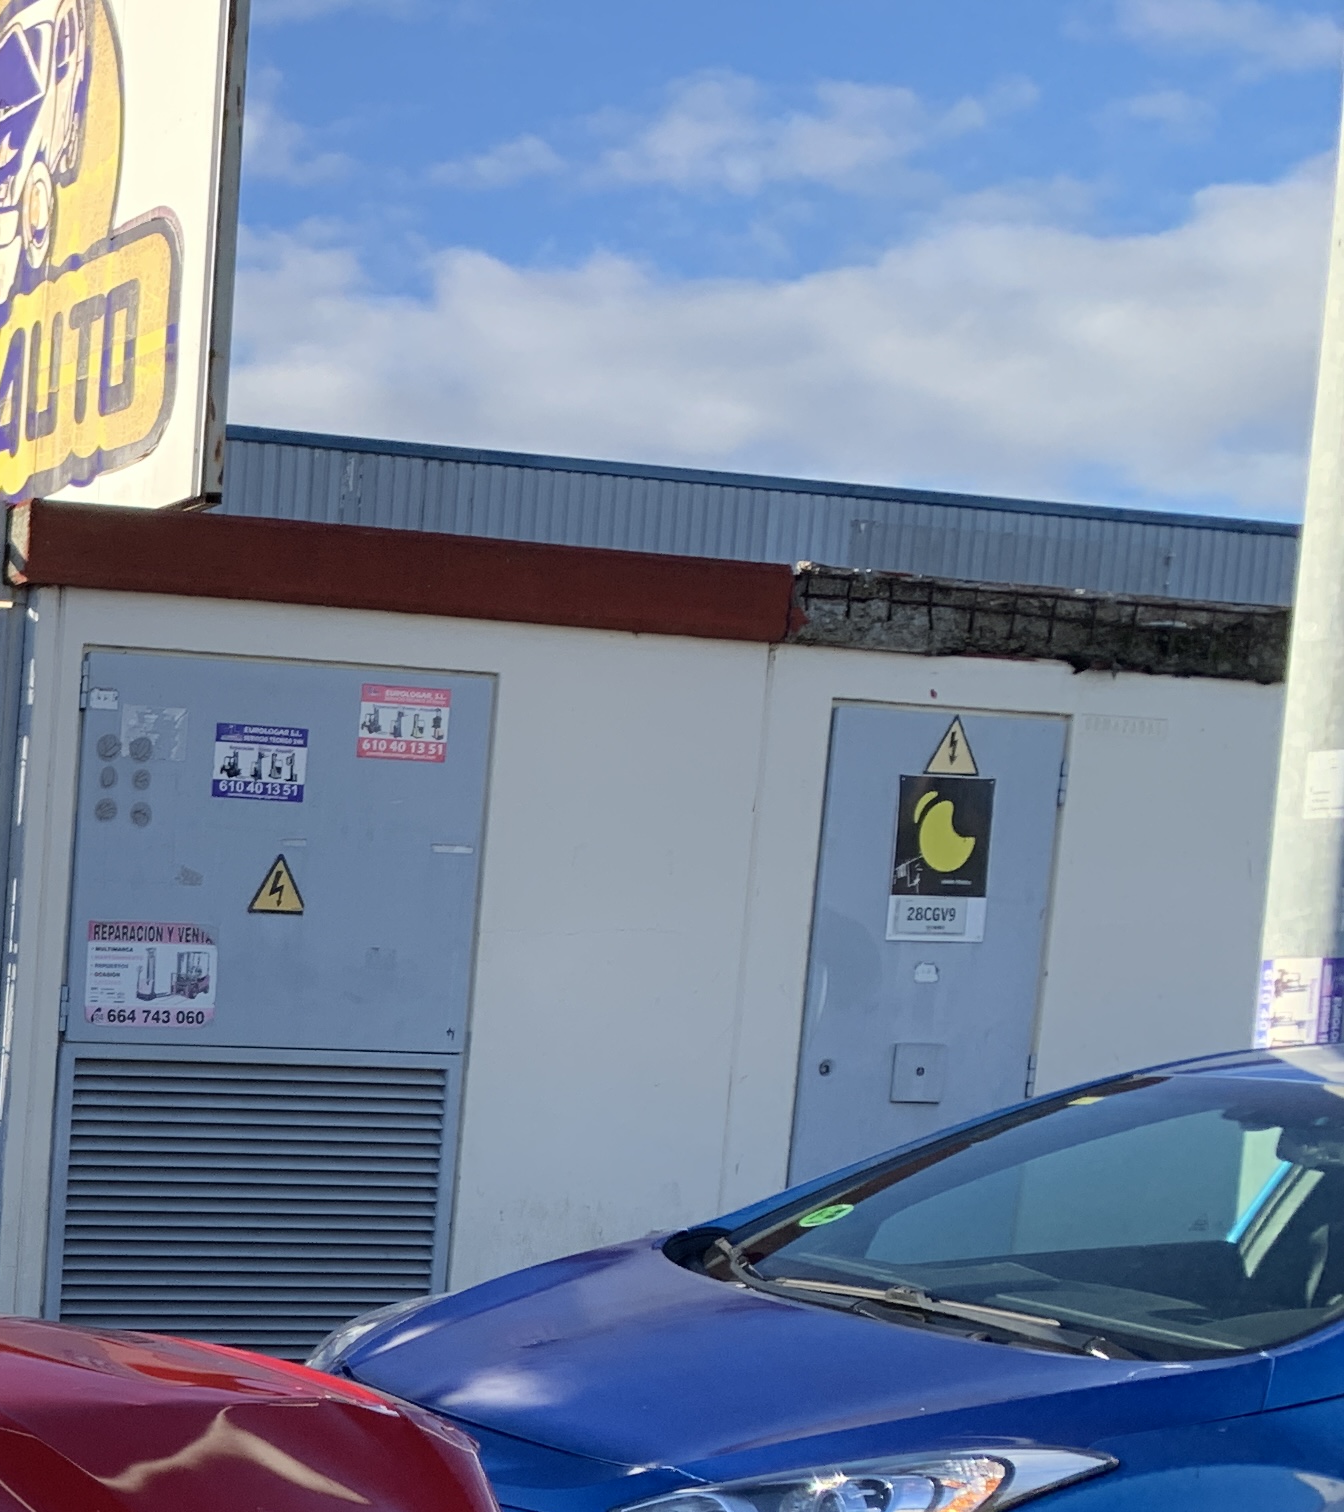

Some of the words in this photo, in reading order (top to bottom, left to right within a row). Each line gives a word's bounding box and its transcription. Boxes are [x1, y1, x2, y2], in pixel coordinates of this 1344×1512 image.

[362, 739, 387, 751] 610
[390, 740, 407, 753] 40
[410, 742, 425, 754] 13
[428, 743, 443, 755] 51
[219, 780, 244, 792] 610
[246, 781, 263, 794] 40
[266, 782, 280, 795] 13
[283, 784, 298, 796] 51
[907, 906, 957, 922] 28CGV9
[93, 924, 163, 942] REPARACION
[166, 926, 174, 942] Y
[107, 1009, 136, 1023] 664
[142, 1010, 171, 1024] 743
[176, 1010, 205, 1025] 060
